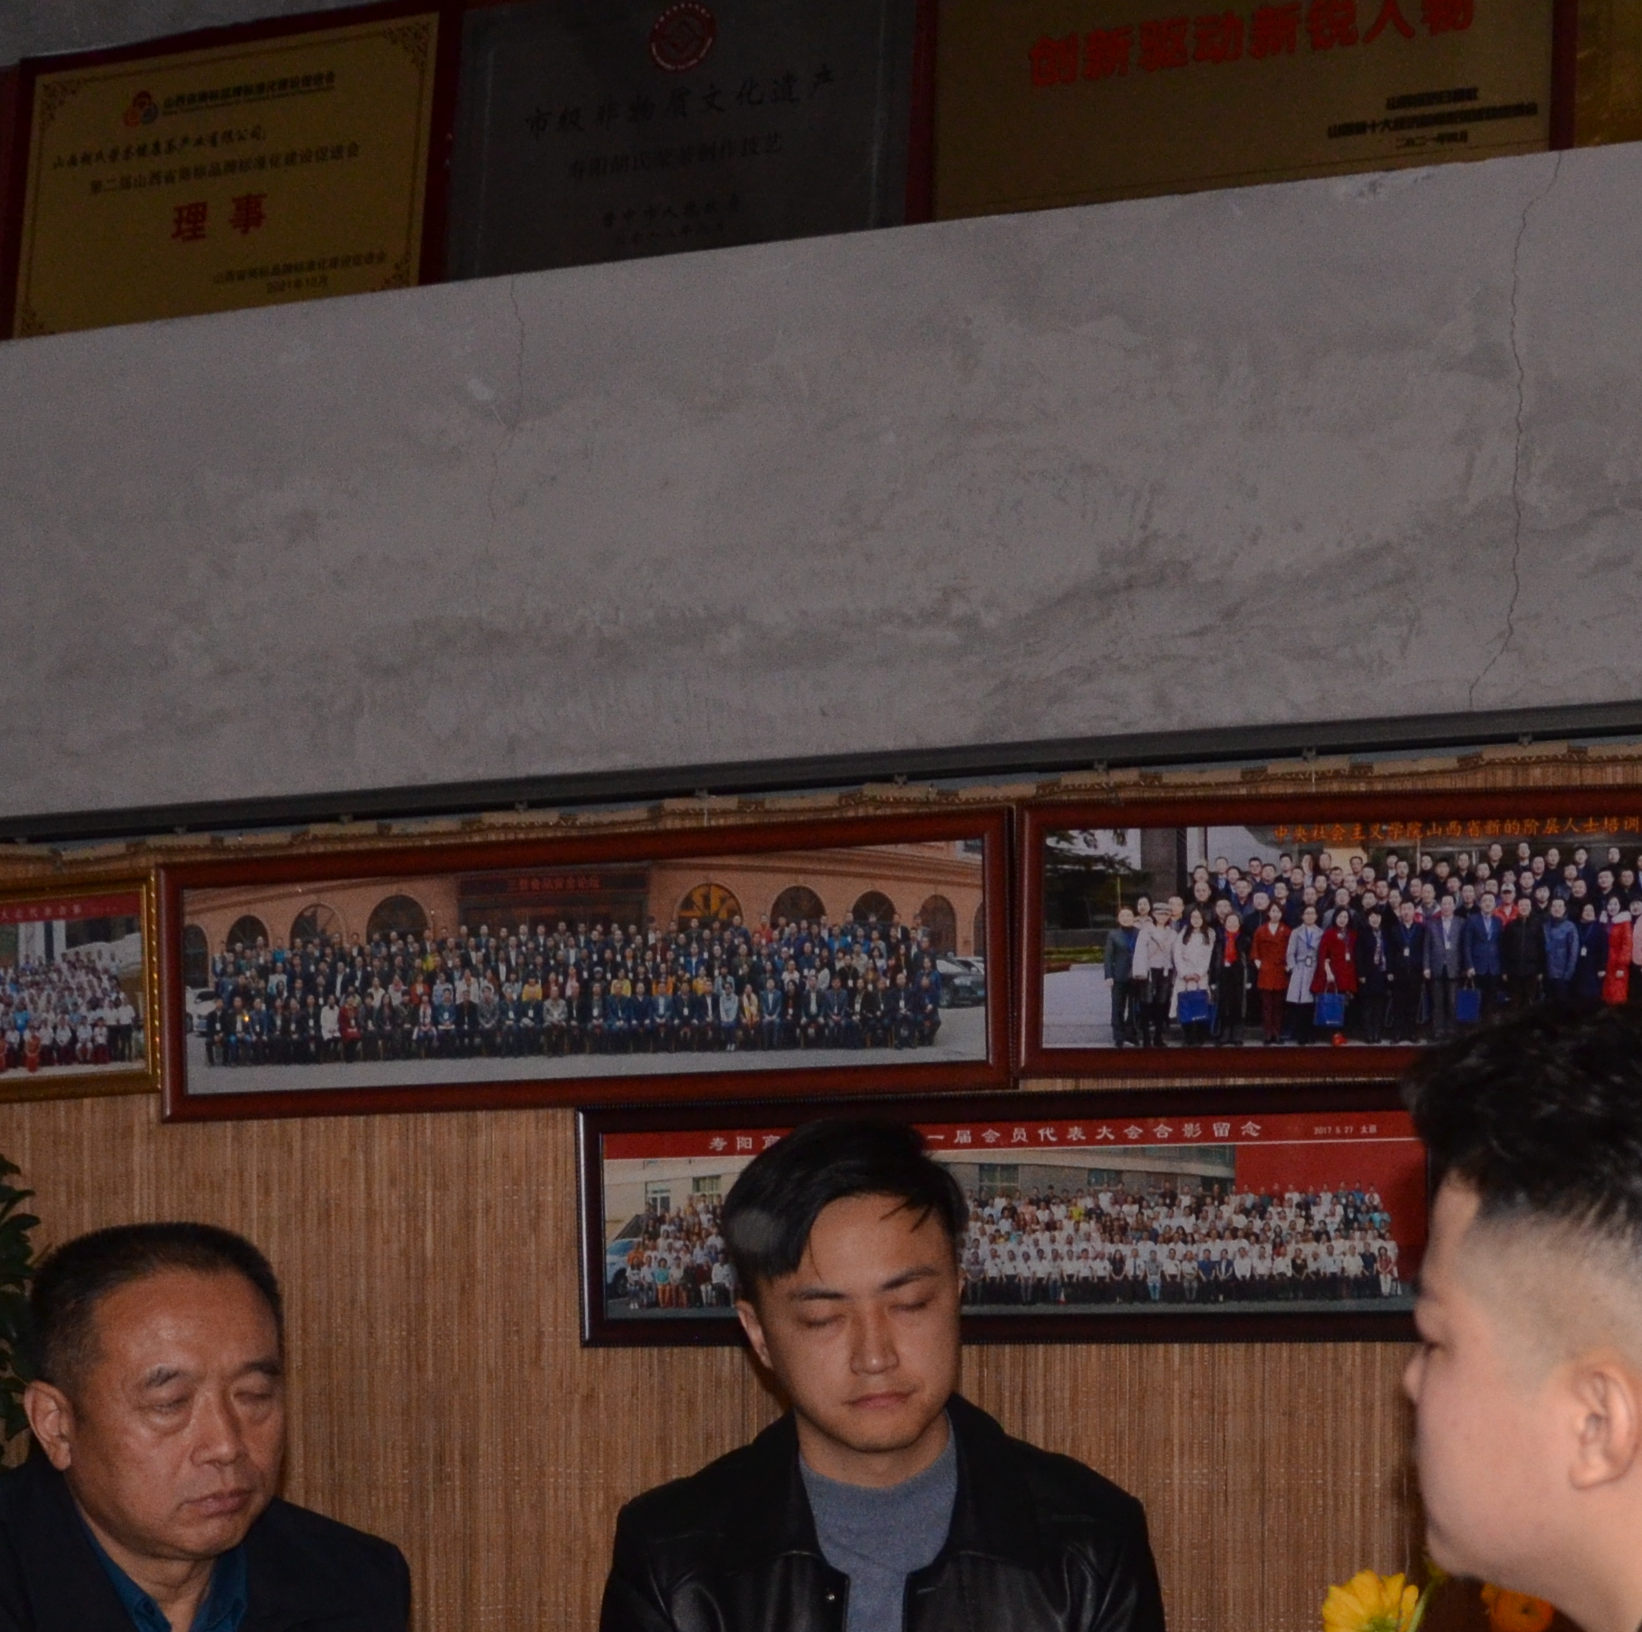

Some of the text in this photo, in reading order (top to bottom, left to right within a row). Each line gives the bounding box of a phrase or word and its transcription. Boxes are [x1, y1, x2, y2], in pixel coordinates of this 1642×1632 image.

[1028, 0, 1474, 87] 创新驱动新锐人物
[171, 193, 268, 242] 理事
